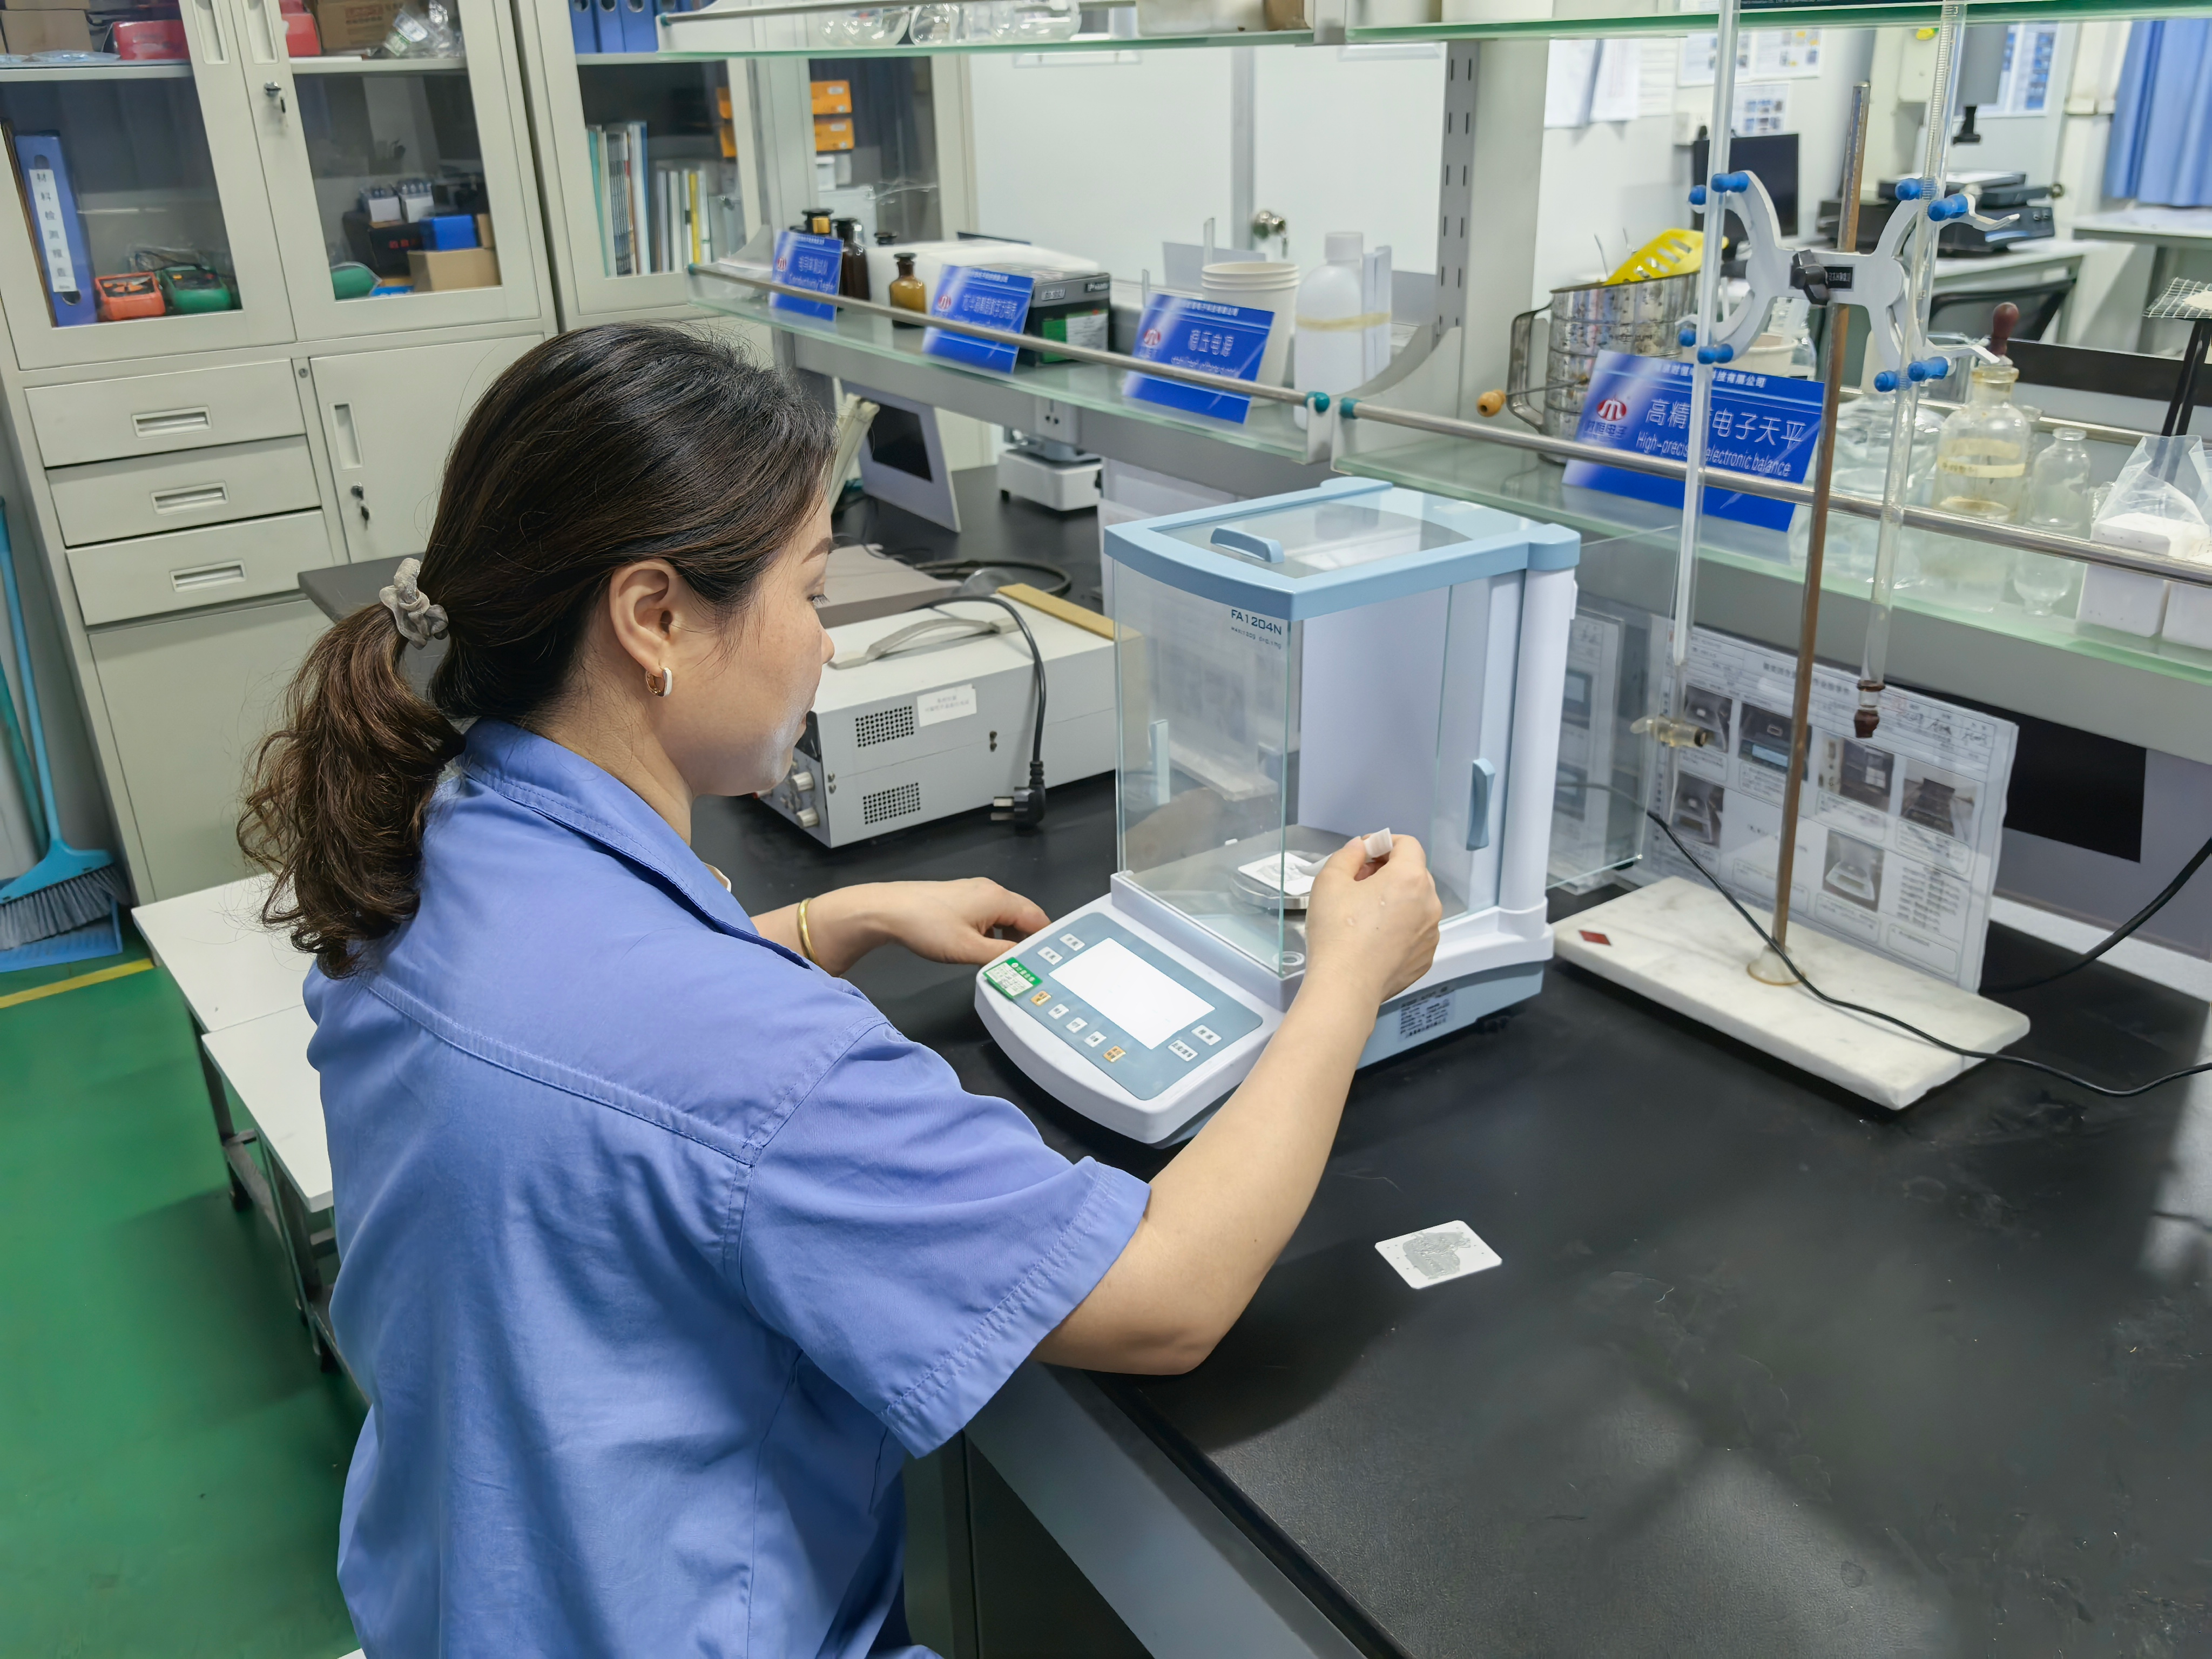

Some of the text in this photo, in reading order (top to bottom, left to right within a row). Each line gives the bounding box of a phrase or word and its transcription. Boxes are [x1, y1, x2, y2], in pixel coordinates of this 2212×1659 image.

[1645, 398, 1807, 449] 高精电子天平
[1636, 430, 1792, 477] High-precis electronic balance
[1231, 609, 1282, 635] FA1204N
